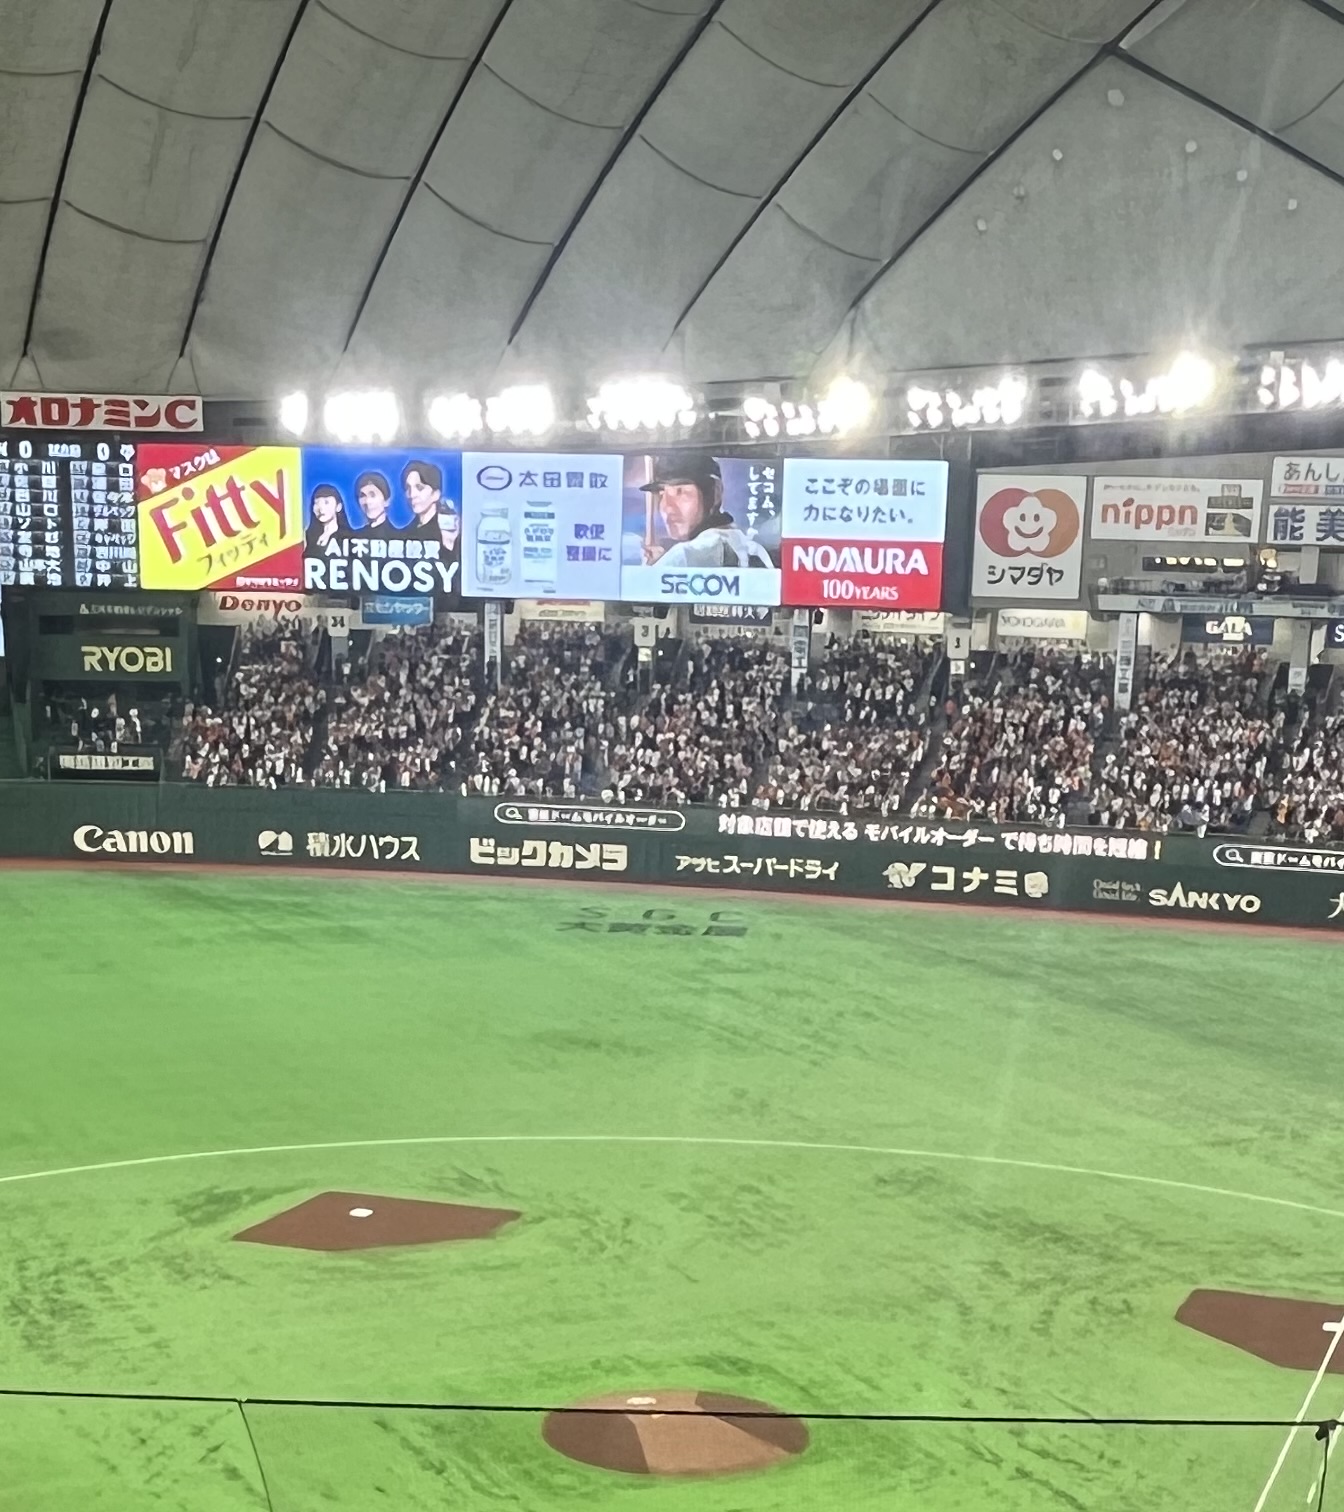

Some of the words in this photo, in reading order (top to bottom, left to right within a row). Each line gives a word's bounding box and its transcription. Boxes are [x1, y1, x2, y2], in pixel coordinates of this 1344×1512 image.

[6, 396, 197, 429] オロナミンC
[150, 468, 287, 564] Fitty
[1101, 497, 1199, 531] nippn
[305, 558, 459, 592] RENOSY
[793, 546, 928, 576] NOMURA
[987, 563, 1064, 586] シマダヤ
[660, 573, 740, 596] SECOM
[219, 595, 302, 618] Denyo
[81, 646, 172, 673] RYOBI
[73, 824, 194, 855] Canon
[306, 831, 421, 861] 積水ハウス
[470, 837, 628, 871] ビックカメラ
[675, 854, 840, 881] アサヒスーパードライ
[1148, 881, 1261, 913] SANKYO
